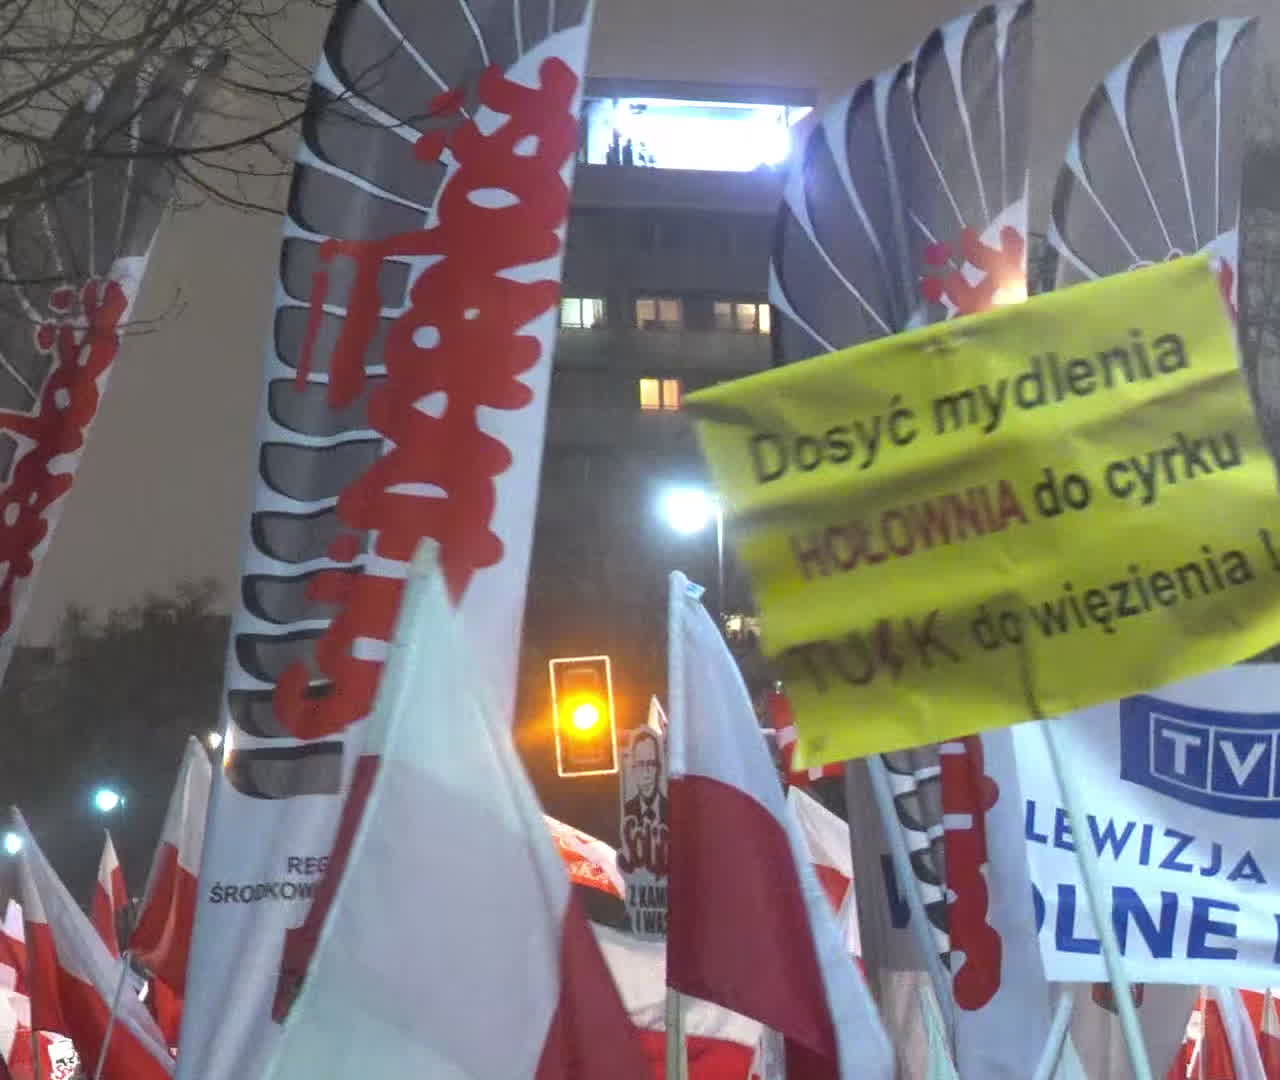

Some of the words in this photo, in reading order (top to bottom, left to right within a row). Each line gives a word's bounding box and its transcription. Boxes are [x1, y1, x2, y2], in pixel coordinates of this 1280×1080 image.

[750, 393, 918, 486] Dosyć
[932, 329, 1189, 435] mydlenia
[791, 479, 1027, 580] HOŁOWNIA
[1033, 467, 1091, 518] do
[1105, 431, 1242, 505] cyrku
[971, 603, 1023, 650] do
[1029, 545, 1255, 637] więzienia
